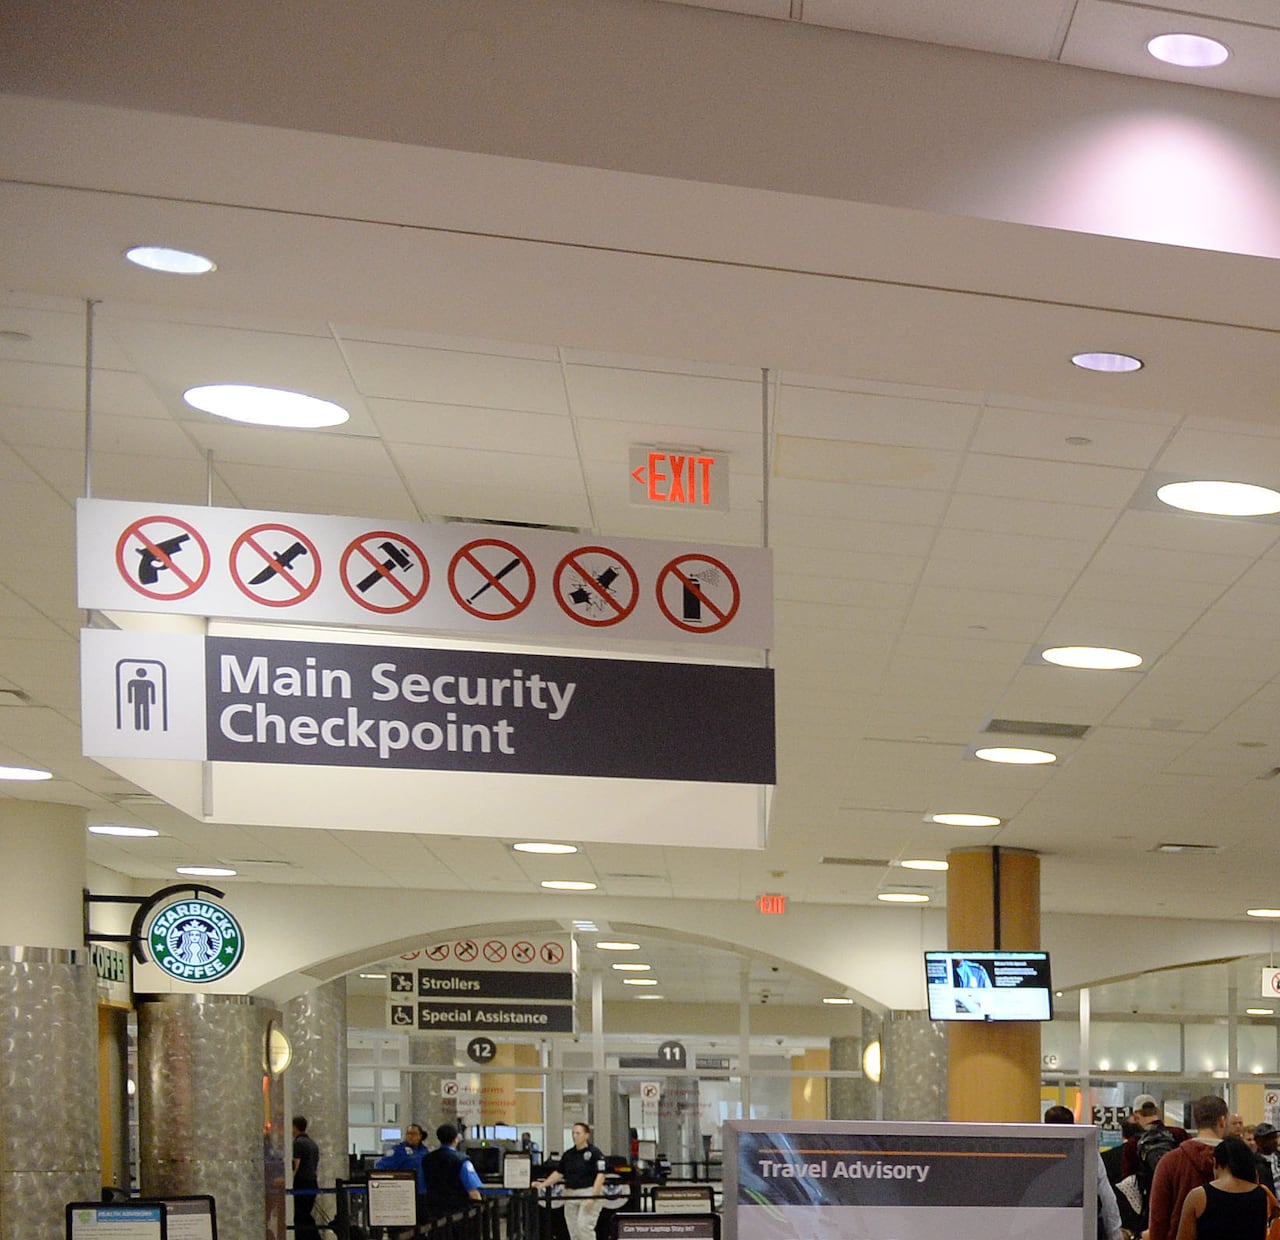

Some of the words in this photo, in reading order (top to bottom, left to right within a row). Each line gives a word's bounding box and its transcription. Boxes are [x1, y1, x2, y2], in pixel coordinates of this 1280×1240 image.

[648, 452, 715, 505] EXIT
[220, 653, 352, 699] Main
[371, 662, 577, 720] Security
[219, 702, 515, 759] Checkpoint
[154, 903, 236, 939] STARBUCKS
[162, 956, 225, 978] COFFEE
[422, 978, 480, 990] Strollers
[422, 1010, 471, 1023] Special
[475, 1010, 548, 1024] Assistance
[473, 1044, 492, 1058] 12
[663, 1047, 681, 1060] 11
[758, 1160, 827, 1178] Travel
[832, 1161, 930, 1182] Advisory
